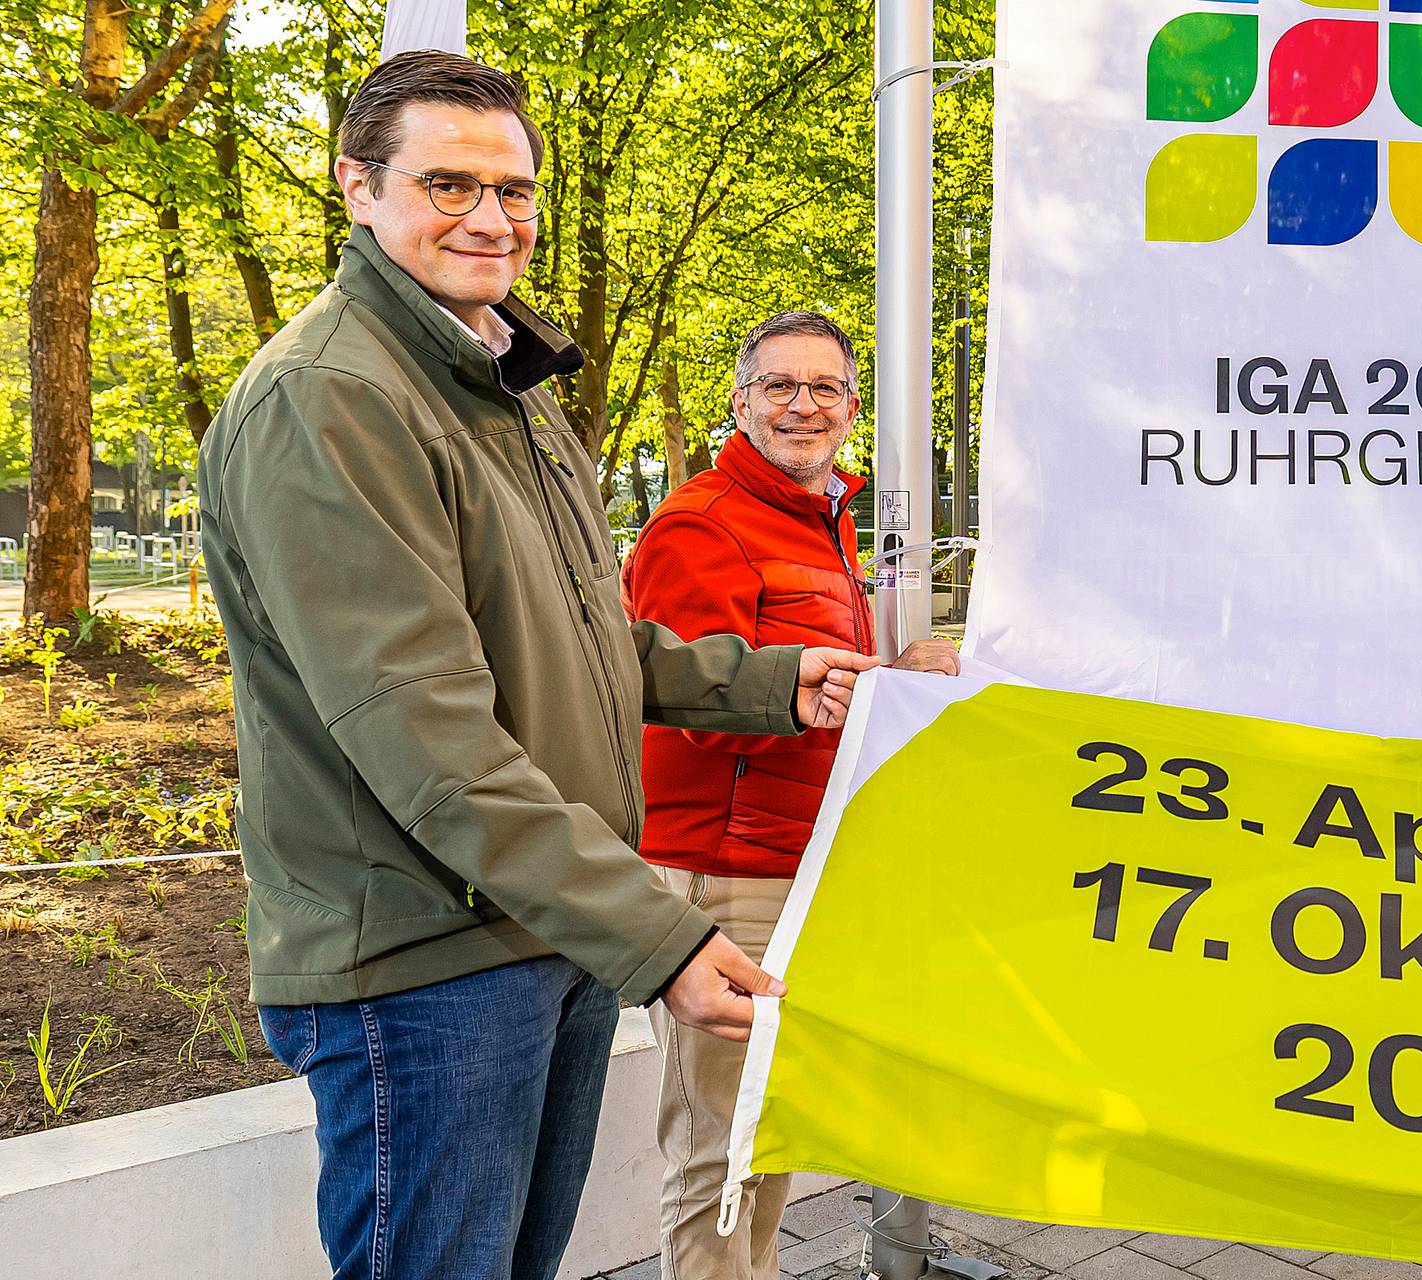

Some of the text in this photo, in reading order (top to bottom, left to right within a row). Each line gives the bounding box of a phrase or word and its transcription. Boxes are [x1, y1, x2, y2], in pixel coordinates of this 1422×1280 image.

[1215, 356, 1349, 416] IGA
[1070, 741, 1265, 836] 23.
[1071, 861, 1230, 962] 17.
